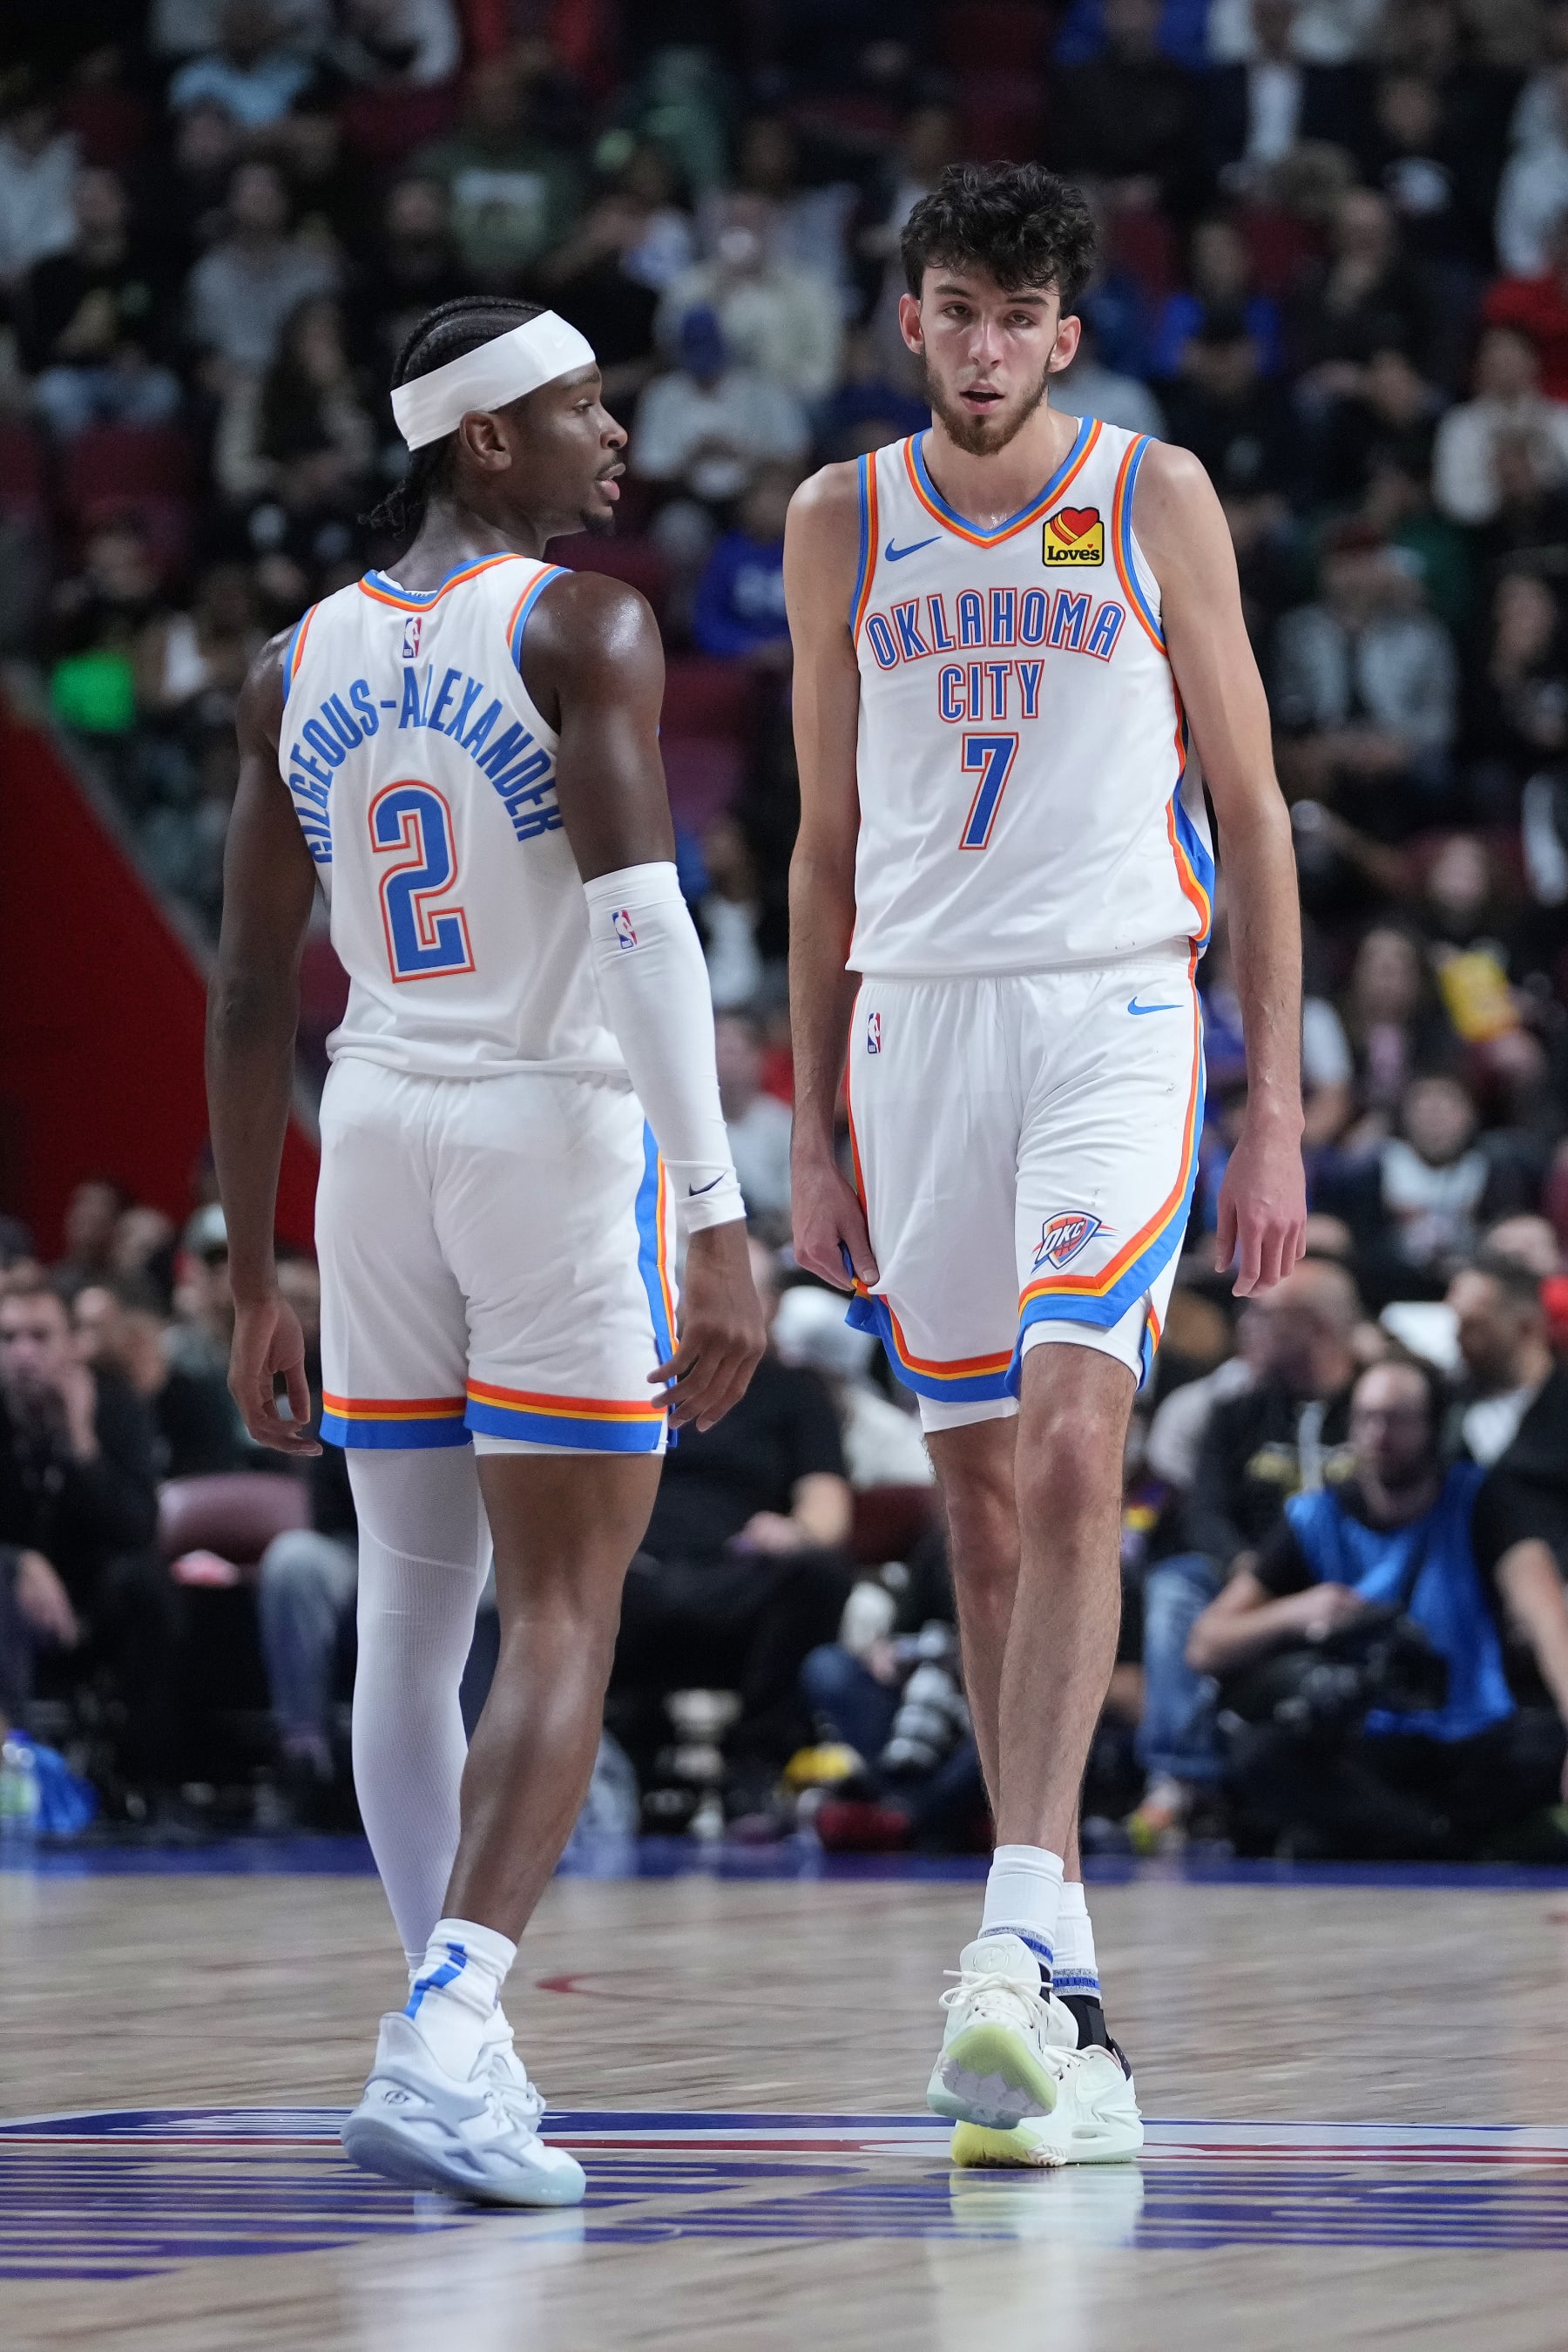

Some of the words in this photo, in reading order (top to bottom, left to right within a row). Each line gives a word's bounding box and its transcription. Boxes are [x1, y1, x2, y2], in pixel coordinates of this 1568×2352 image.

[865, 587, 1126, 671] OKLAHOMA
[938, 659, 1045, 723] CITY
[288, 664, 565, 863] GILGEOUS-ALEXANDER
[958, 732, 1019, 850] 7
[368, 779, 476, 983] 2
